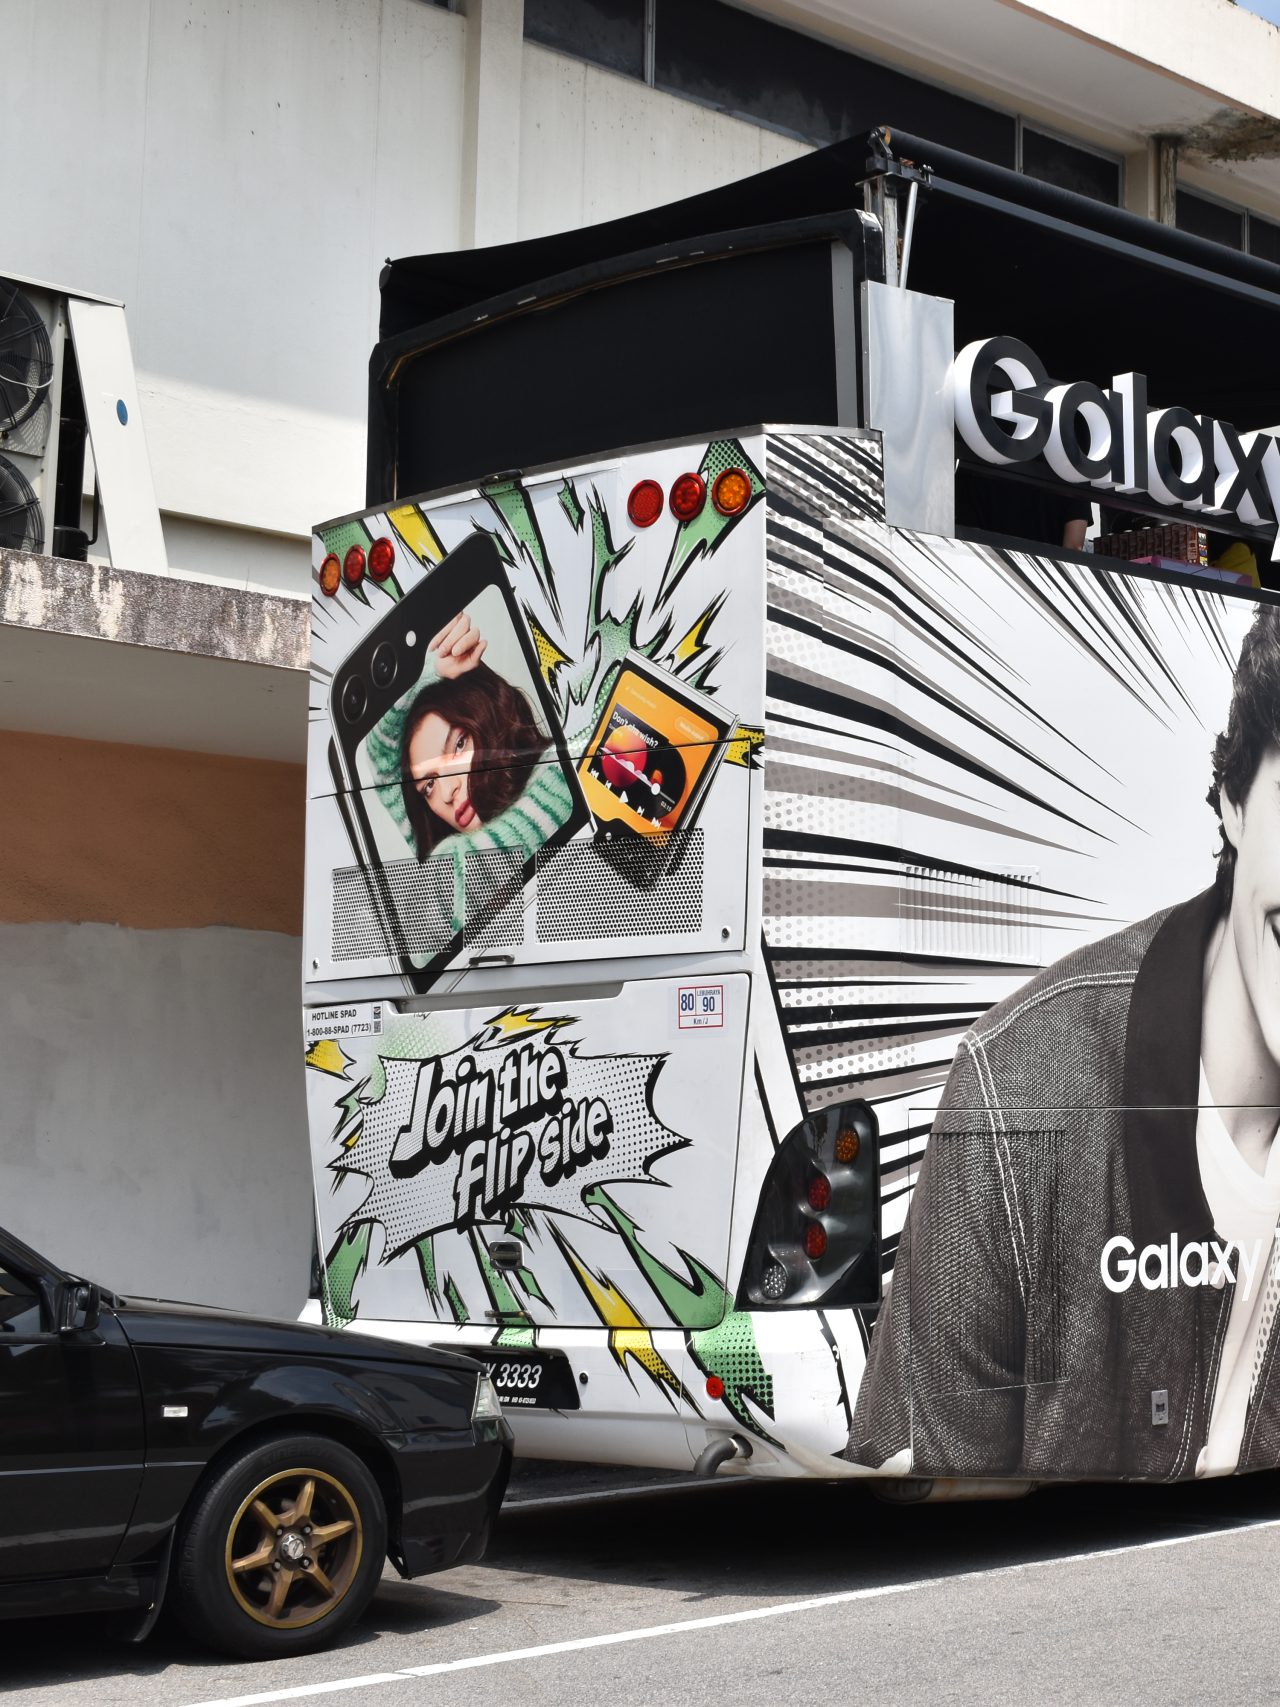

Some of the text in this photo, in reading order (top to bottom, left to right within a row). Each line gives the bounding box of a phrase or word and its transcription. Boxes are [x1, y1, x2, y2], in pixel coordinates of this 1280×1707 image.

[612, 711, 628, 726] Don't
[681, 993, 715, 1012] 80 90
[312, 1009, 357, 1021] HOTLINE SPAD
[306, 1023, 372, 1036] 1-800-88-SPAD (7723)
[390, 1044, 566, 1172] Join the
[539, 1096, 612, 1182] side
[1100, 1232, 1264, 1302] Galaxy
[496, 1363, 543, 1388] 3333
